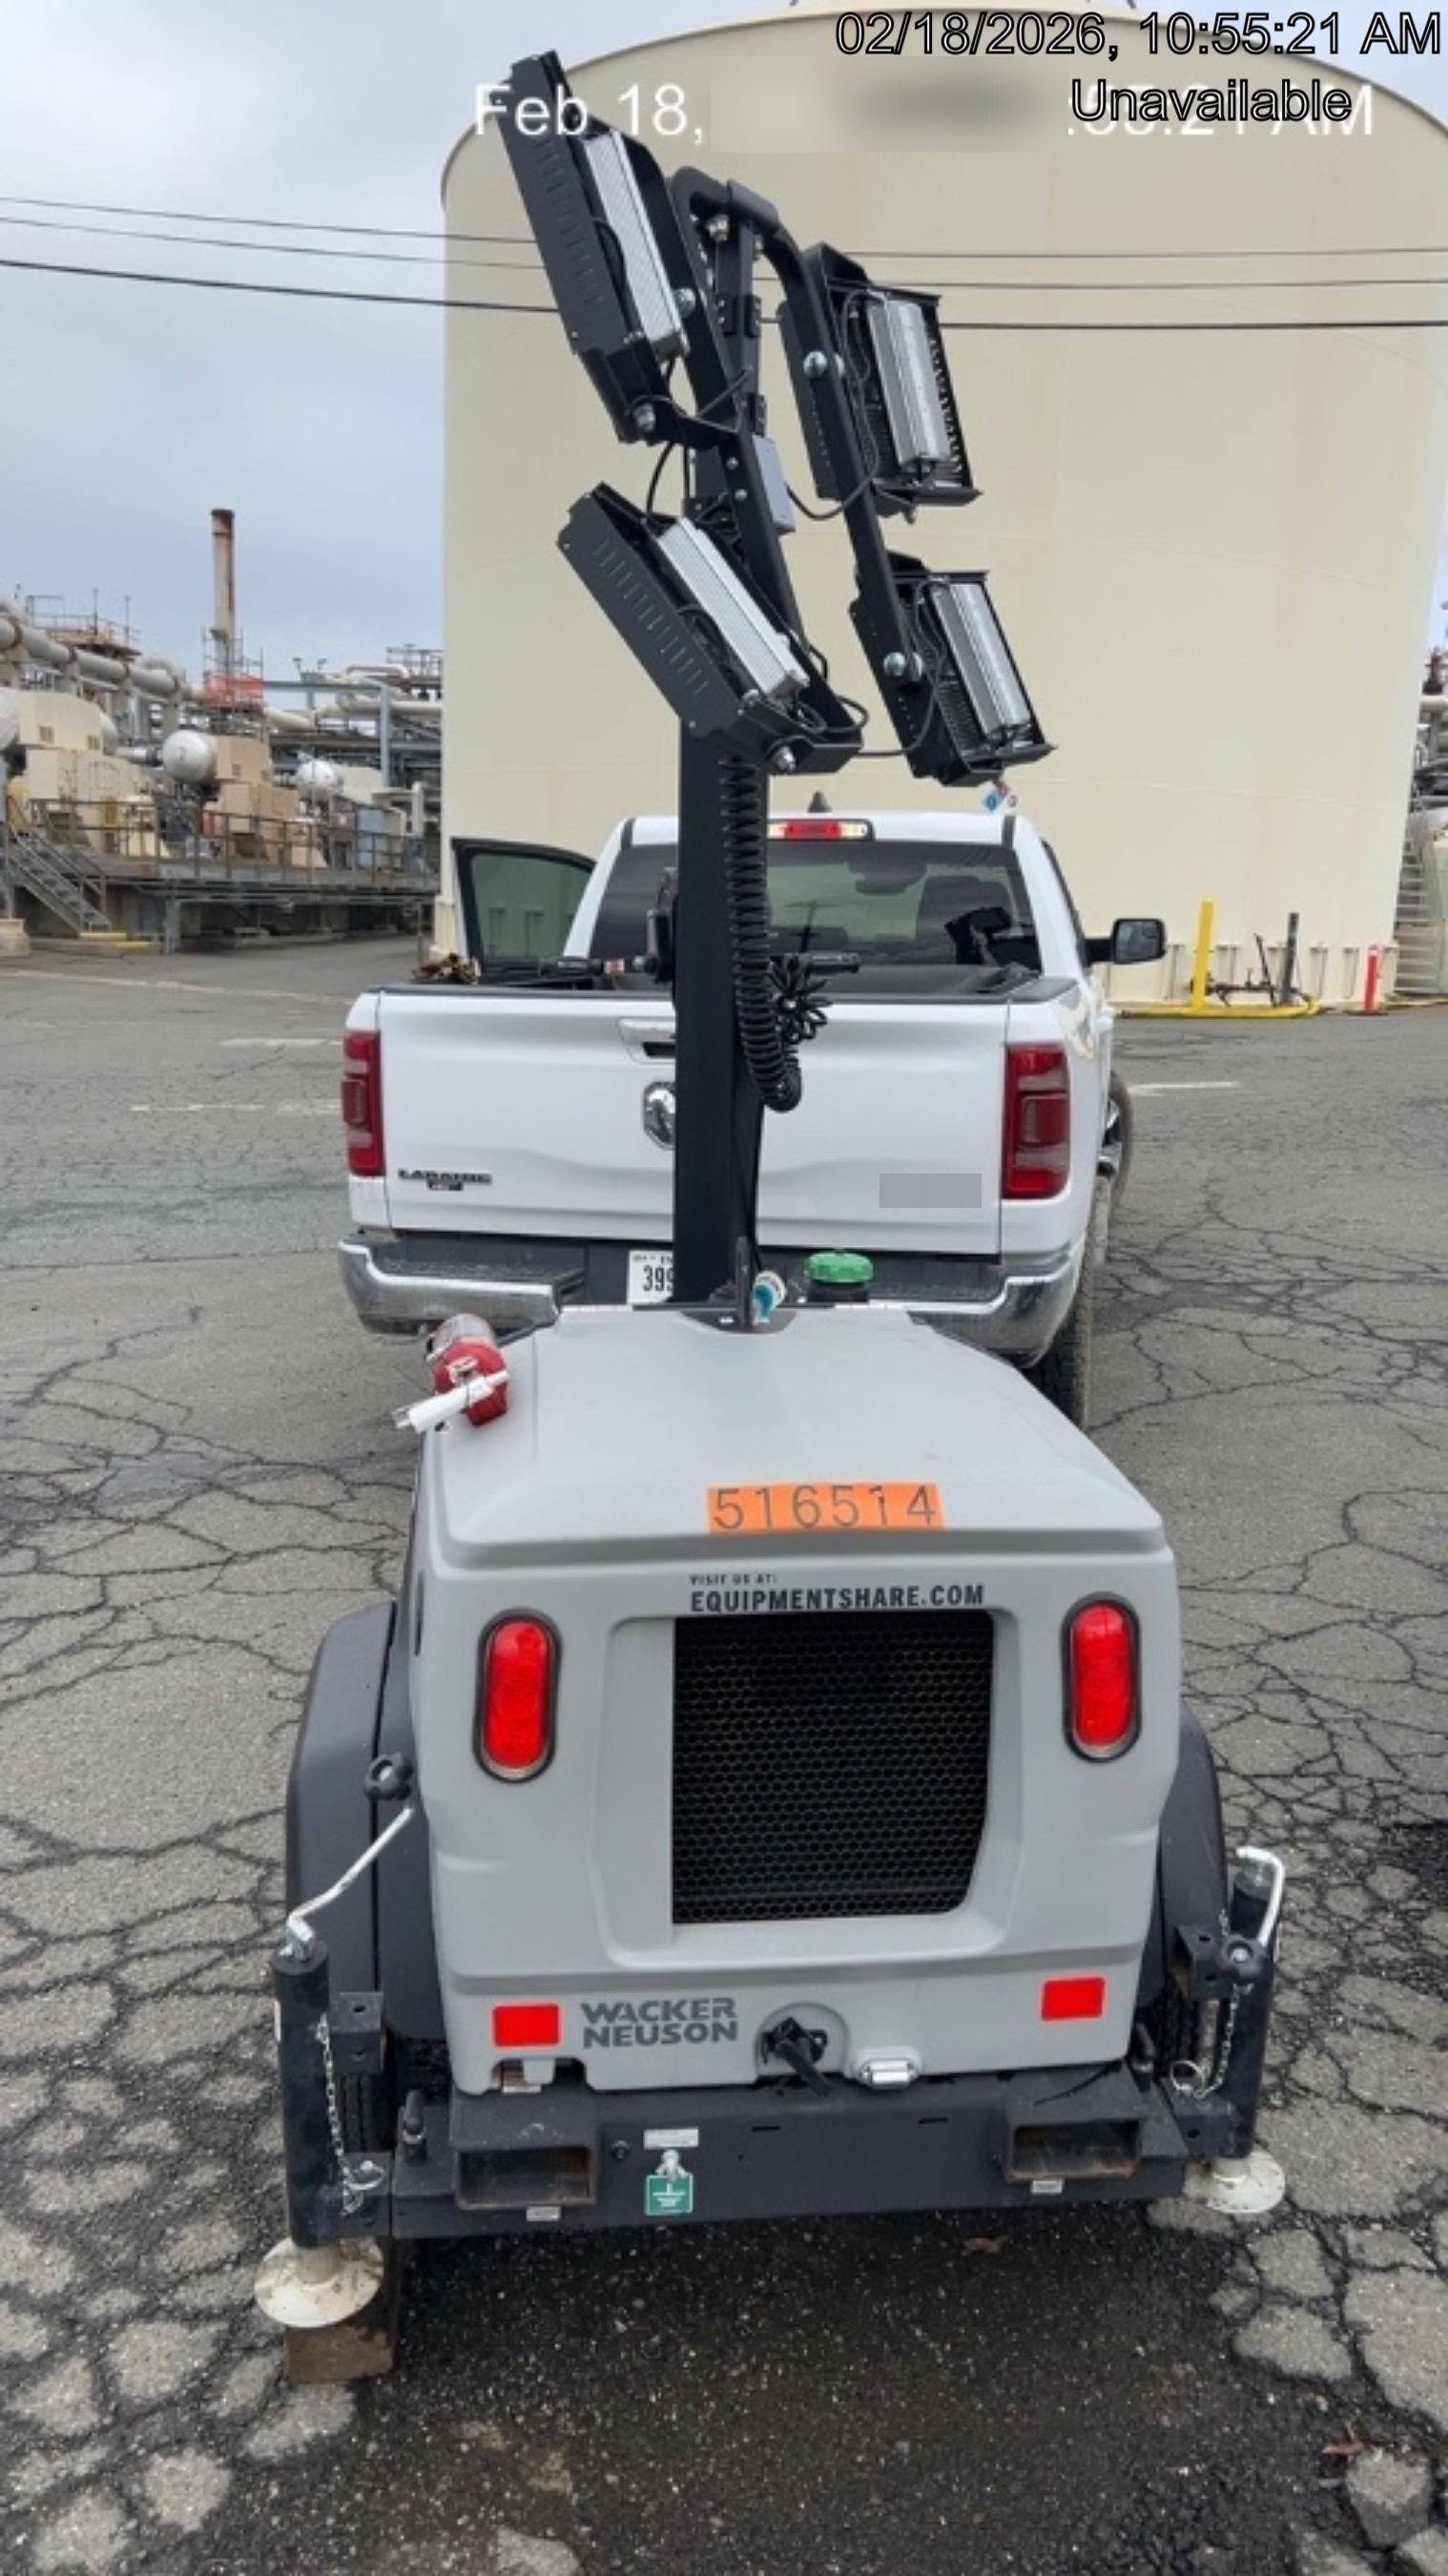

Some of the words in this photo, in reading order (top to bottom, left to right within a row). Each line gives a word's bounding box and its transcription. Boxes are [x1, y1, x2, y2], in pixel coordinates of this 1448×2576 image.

[714, 1485, 934, 1529] 516514
[692, 1585, 983, 1612] EQUIPMENTSHARE.COM
[581, 1997, 737, 2024] WACKER
[584, 2020, 738, 2047] NEUSON
